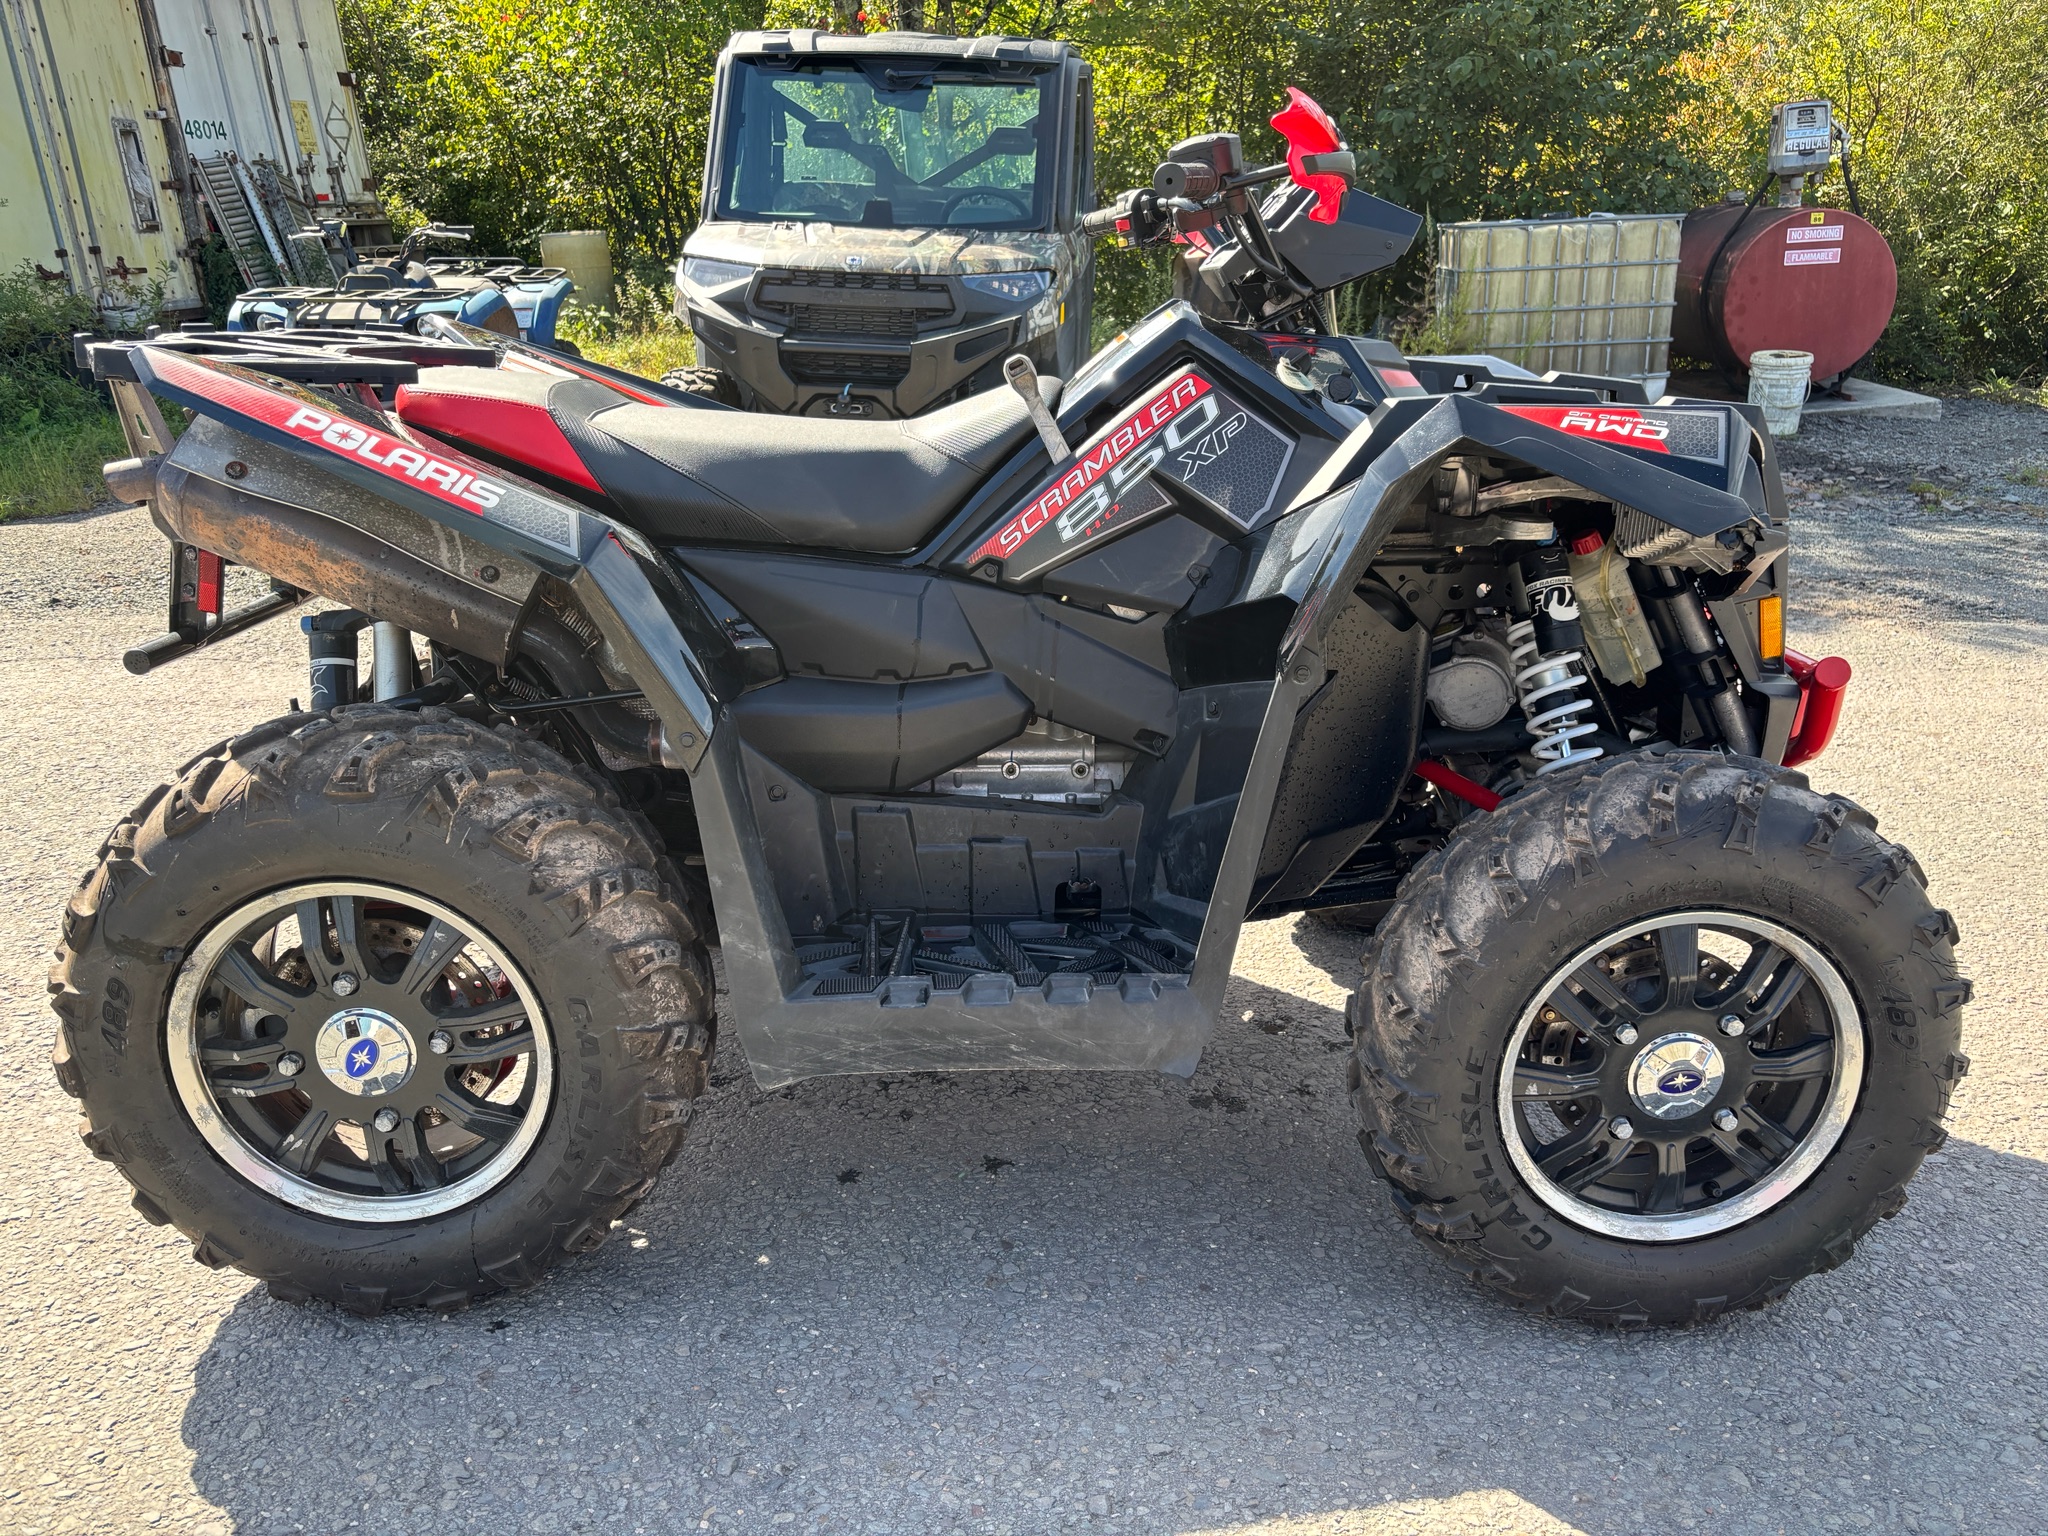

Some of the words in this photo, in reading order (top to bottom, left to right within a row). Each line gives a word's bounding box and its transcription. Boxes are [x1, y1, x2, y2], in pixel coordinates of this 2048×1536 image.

[184, 119, 227, 140] 48014
[1786, 137, 1829, 151] REGULAR
[1791, 230, 1803, 240] NO
[1804, 228, 1840, 239] SMOKING
[1791, 252, 1834, 262] FLAMMABLE
[1560, 416, 1670, 440] AWD
[1598, 413, 1668, 426] DEMAND
[284, 407, 507, 509] POLARIS
[1000, 377, 1198, 555] SCRAMBLER
[1055, 393, 1221, 543] 850
[1177, 412, 1247, 482] XP
[1540, 577, 1567, 587] RACING
[526, 994, 604, 1219] CARLISLE
[1461, 1045, 1553, 1251] CARLISLE
